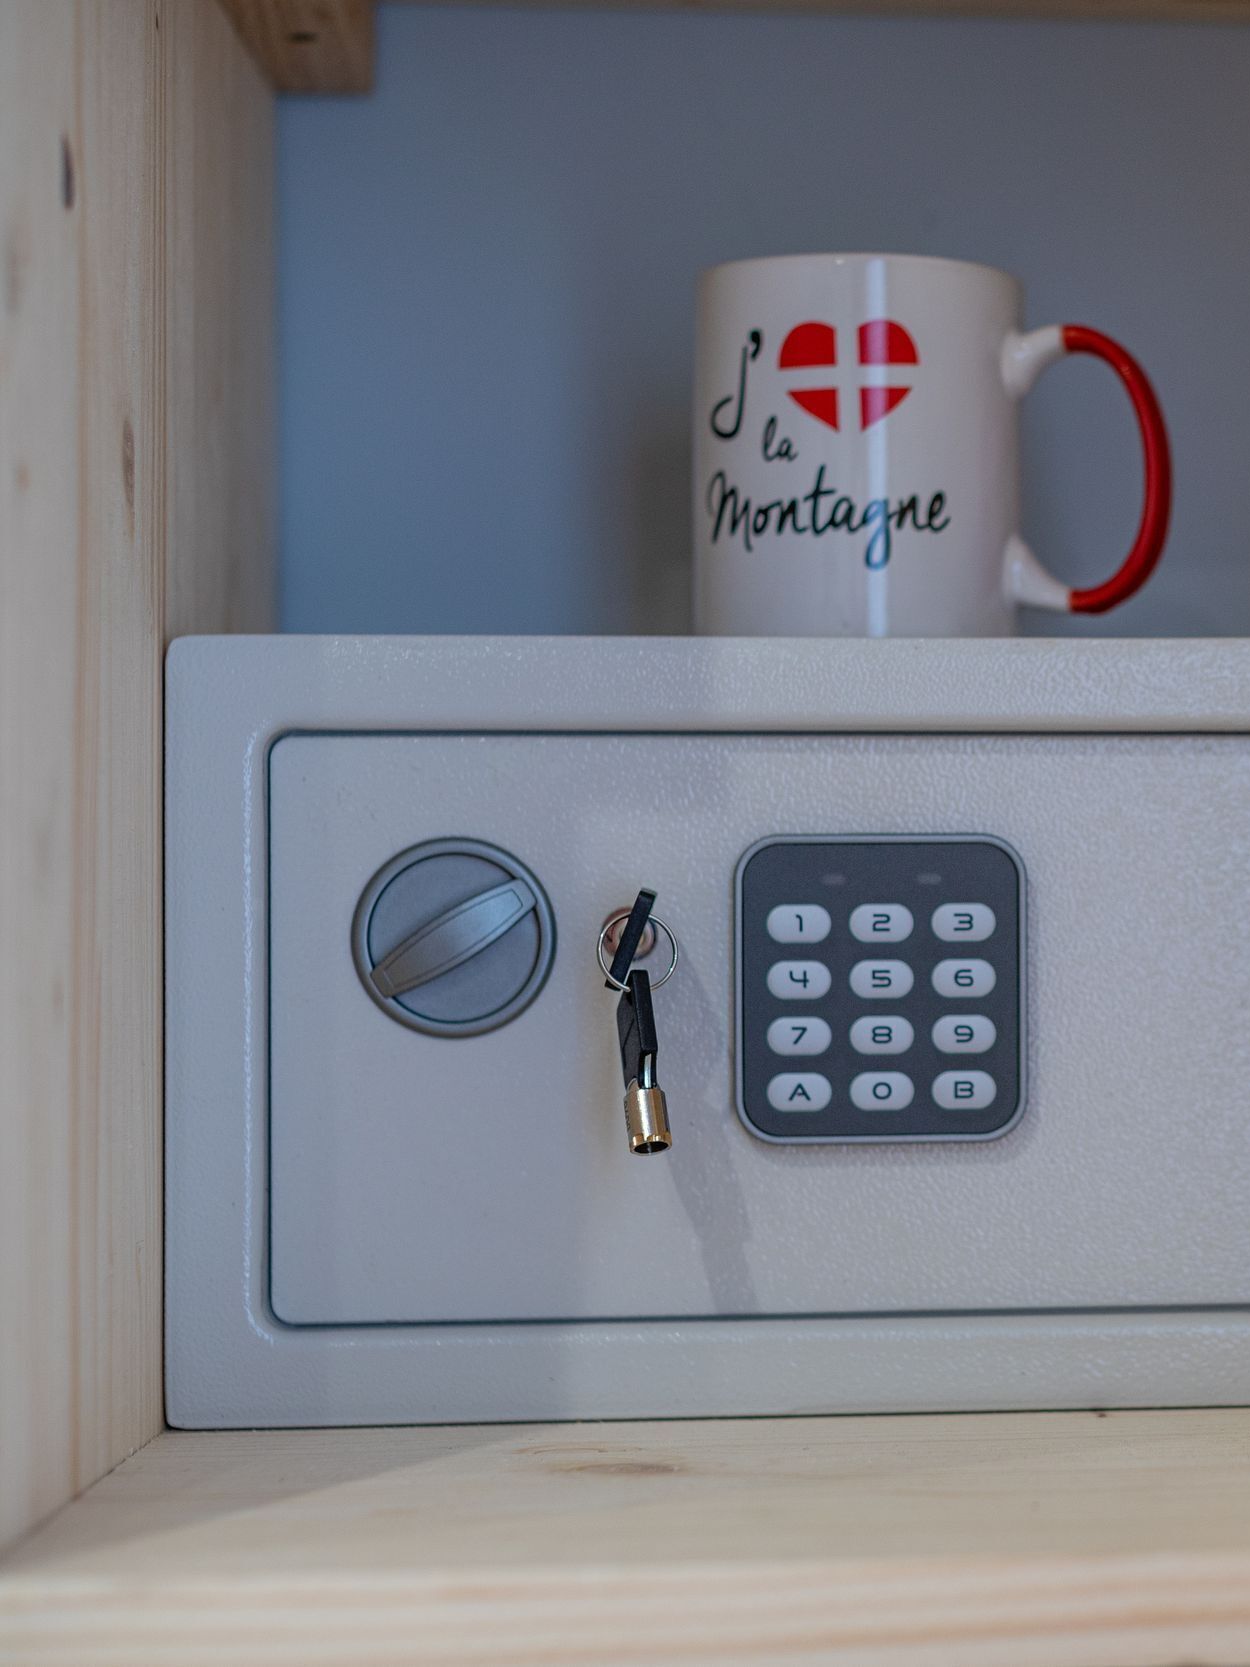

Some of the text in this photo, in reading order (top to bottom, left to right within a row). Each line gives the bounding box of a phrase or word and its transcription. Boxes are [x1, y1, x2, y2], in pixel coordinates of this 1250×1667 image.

[762, 415, 798, 462] la
[708, 464, 951, 570] Montagne
[796, 913, 973, 932] 1 2 3
[790, 969, 974, 988] 4 5 6
[792, 1025, 974, 1045] 7 8 9
[789, 1084, 811, 1101] A
[954, 1081, 974, 1099] B
